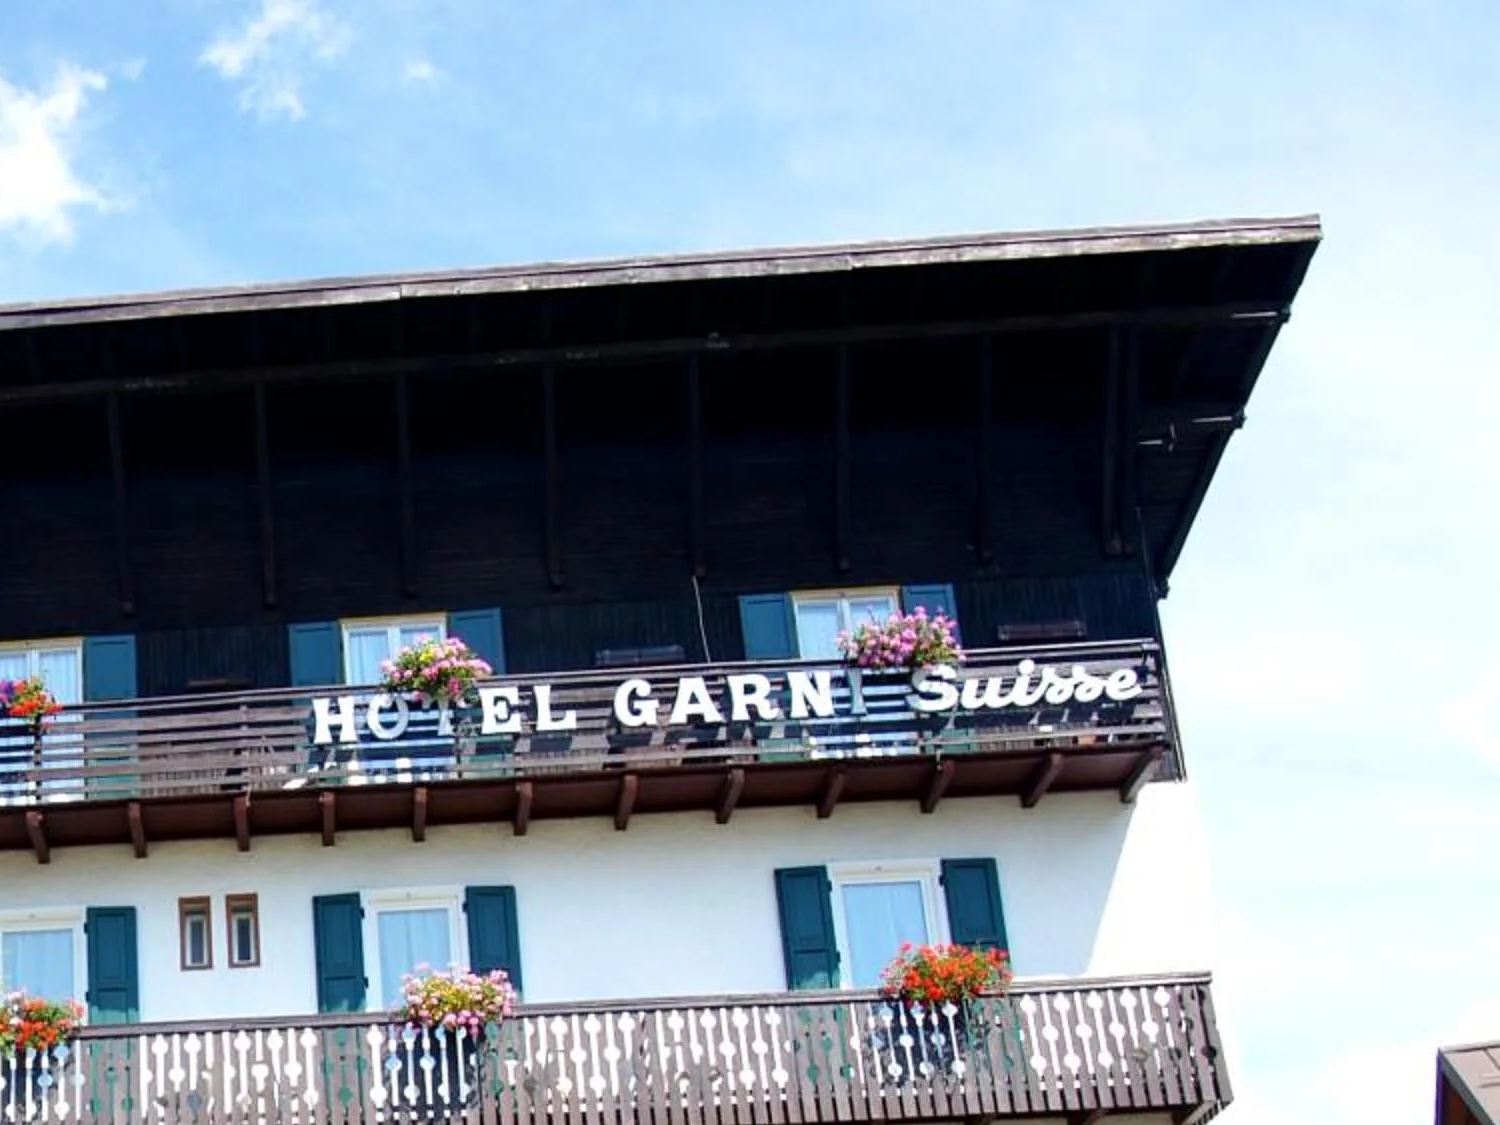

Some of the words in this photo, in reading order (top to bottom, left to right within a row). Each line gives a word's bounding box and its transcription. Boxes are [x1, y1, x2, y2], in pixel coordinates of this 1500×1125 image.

[312, 685, 577, 744] HOTEL
[613, 670, 867, 727] GARNI
[905, 658, 1143, 712] Suisse
